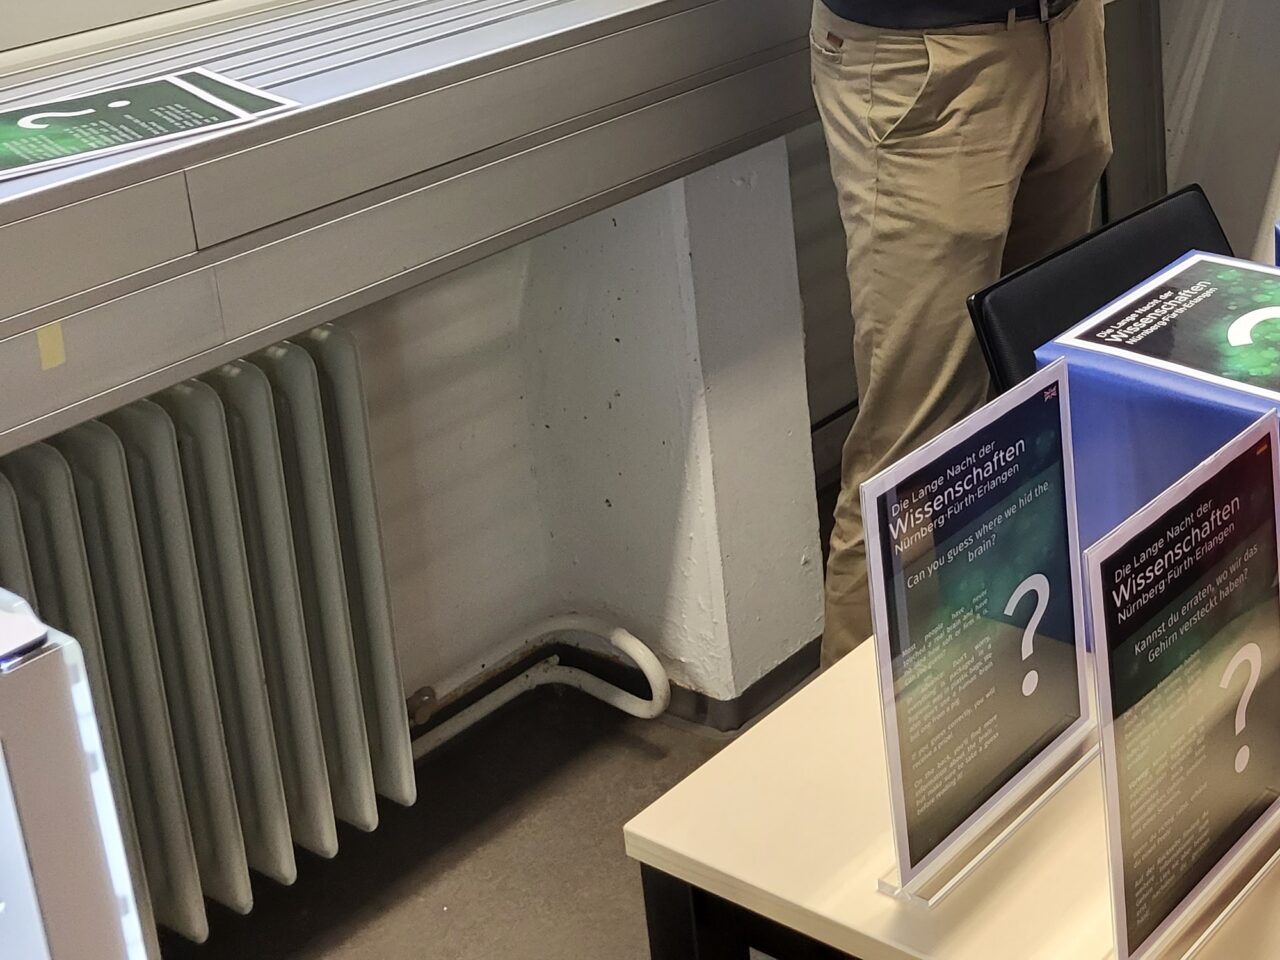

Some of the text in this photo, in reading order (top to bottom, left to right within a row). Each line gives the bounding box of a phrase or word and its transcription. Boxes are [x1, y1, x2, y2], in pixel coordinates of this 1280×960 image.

[1096, 290, 1174, 338] Die Lange Nacht der
[1105, 280, 1212, 342] Wissenschaften
[888, 439, 1024, 543] Wissenschaften
[891, 441, 995, 517] Die Lange Nacht der
[906, 481, 1048, 590] Can you guess where we hid the
[968, 532, 996, 563] brain?
[1111, 496, 1239, 612] Wissenschaften
[1114, 500, 1211, 584] Die Lange Nacht der
[1134, 544, 1257, 656] Kannst du erraten, wo wir das
[1148, 566, 1248, 664] Gehirn versteckt haben?
